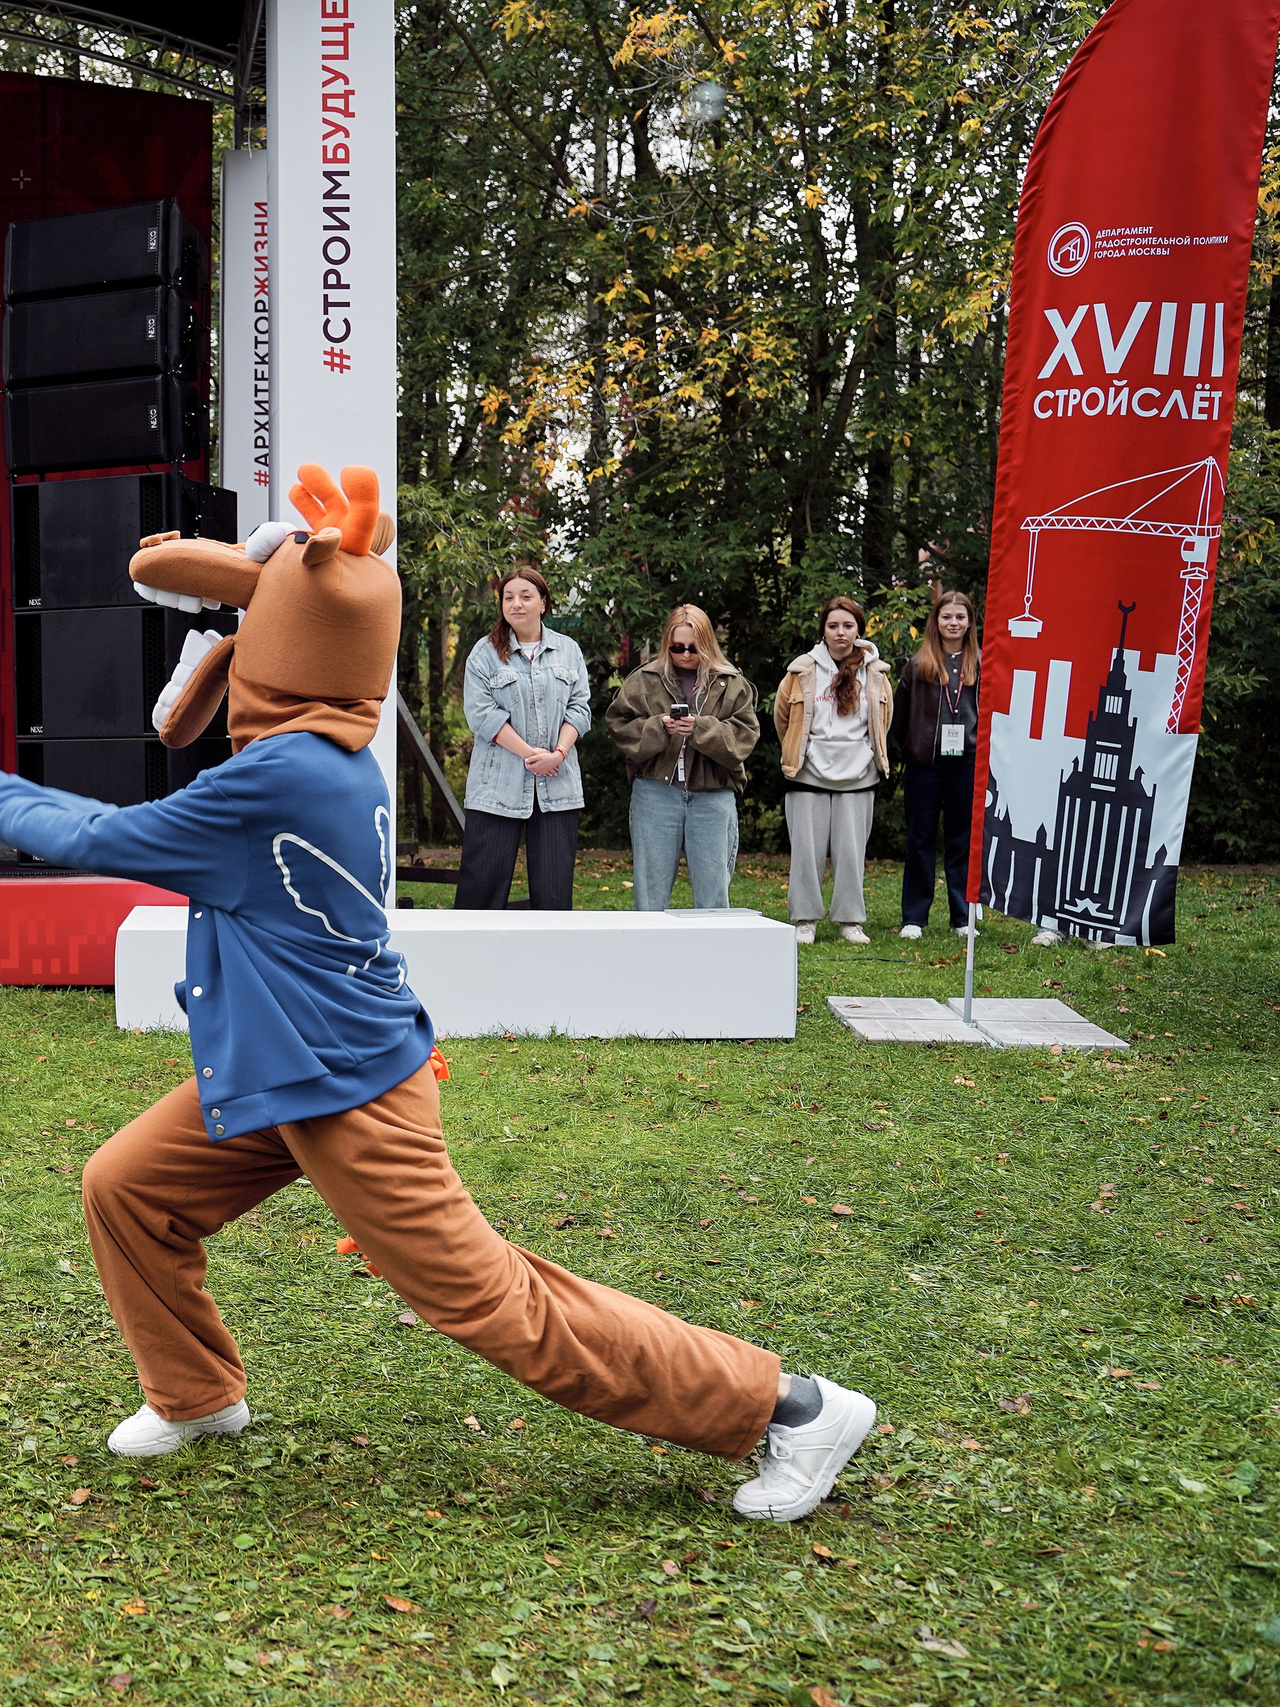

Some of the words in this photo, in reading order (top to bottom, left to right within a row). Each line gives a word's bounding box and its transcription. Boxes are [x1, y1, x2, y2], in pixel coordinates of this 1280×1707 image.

[149, 230, 157, 250] NEXO
[1095, 226, 1154, 239] ДЕПАРТАМЕНТ
[1094, 235, 1190, 249] ГРАДОСТРОИТЕЛЬНОЙ
[1093, 249, 1125, 260] ГОРОДА
[1128, 248, 1170, 257] МОСКВЫ
[1036, 301, 1224, 379] XVIII
[1033, 379, 1223, 420] СТРОЙСЛЁТ
